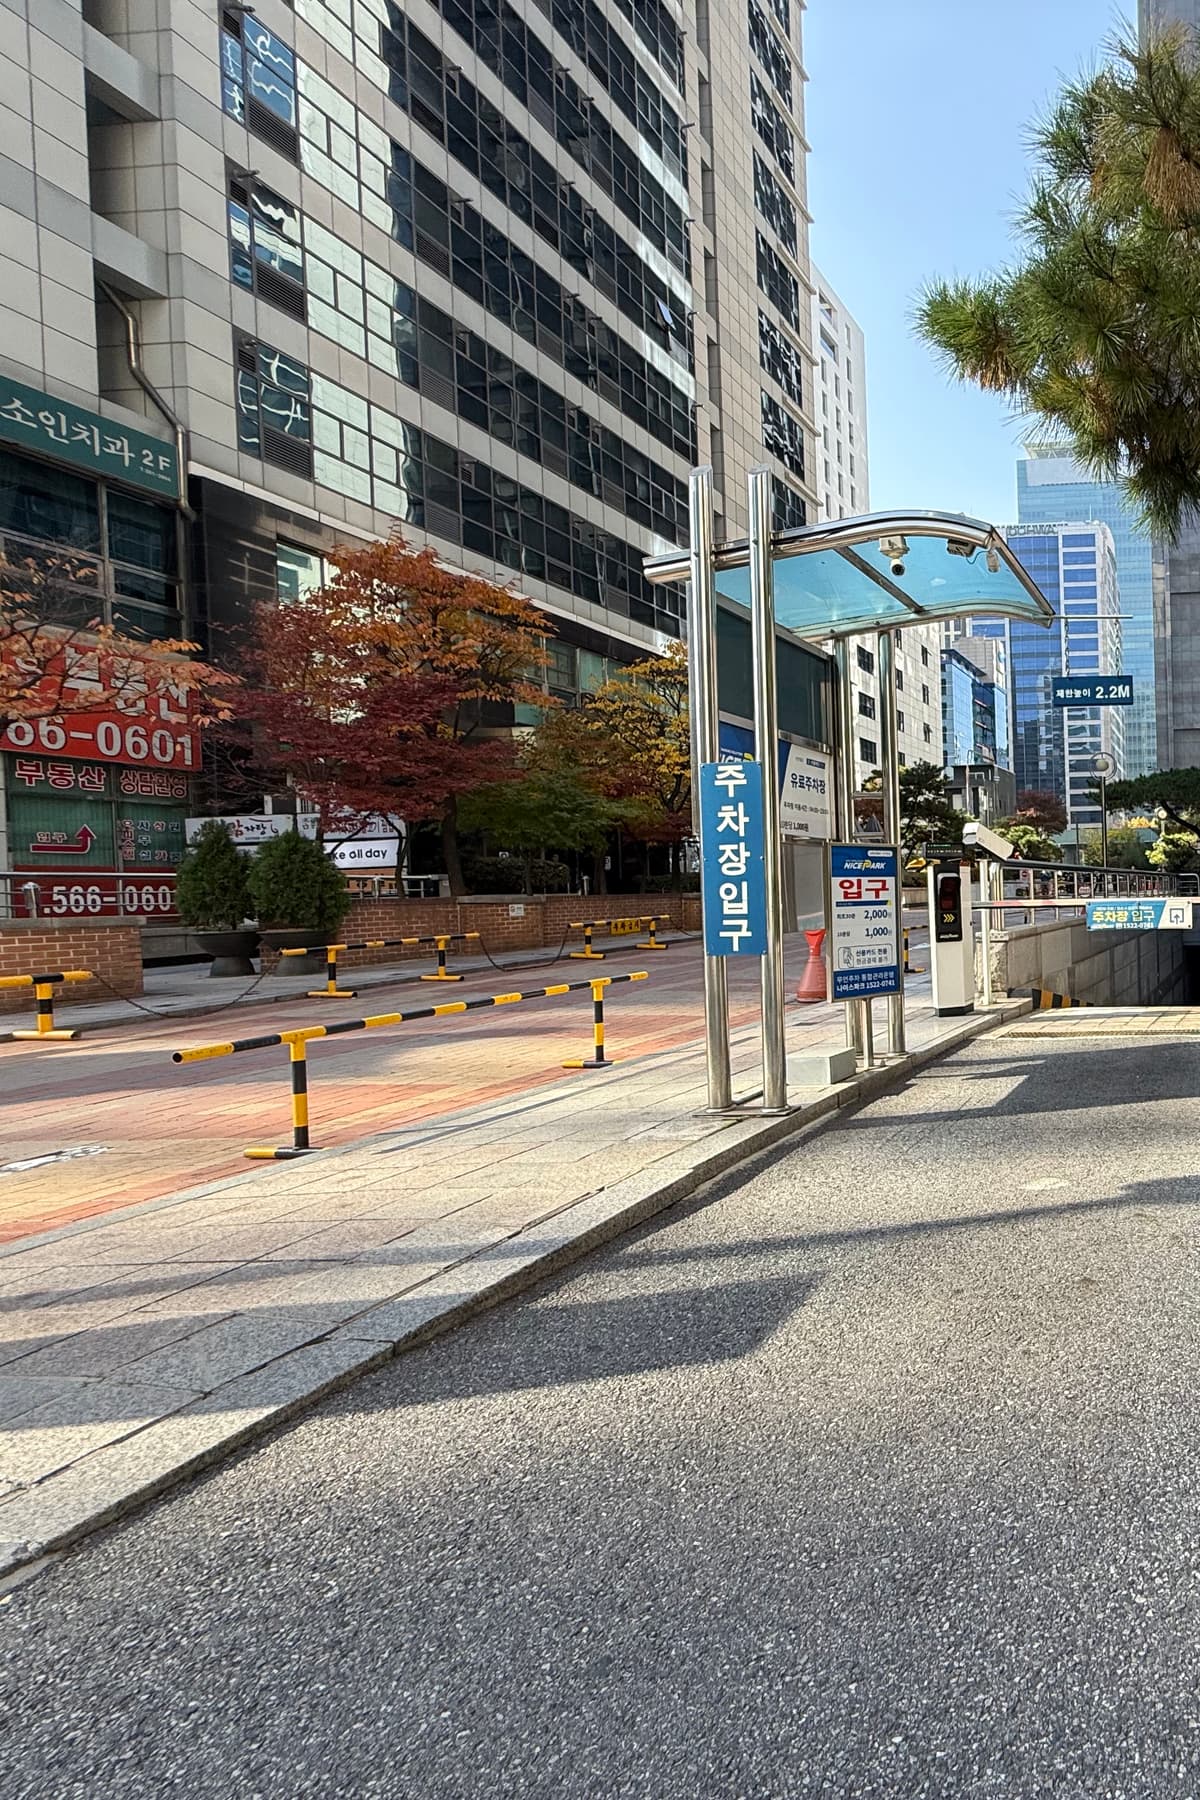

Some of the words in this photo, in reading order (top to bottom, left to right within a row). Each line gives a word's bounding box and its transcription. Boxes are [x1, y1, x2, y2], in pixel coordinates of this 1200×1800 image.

[142, 449, 171, 471] 2F
[1096, 685, 1131, 699] 2.2M
[15, 759, 106, 792] 부동산
[120, 769, 188, 799] 상담환영
[790, 772, 826, 795] 유료주차장
[349, 849, 363, 859] all
[365, 848, 387, 862] day
[714, 765, 753, 952] 주차장입구
[843, 860, 887, 871] NICEPARK
[838, 879, 889, 899] 입구
[1092, 911, 1128, 923] 주차장
[1131, 910, 1155, 922] 입구
